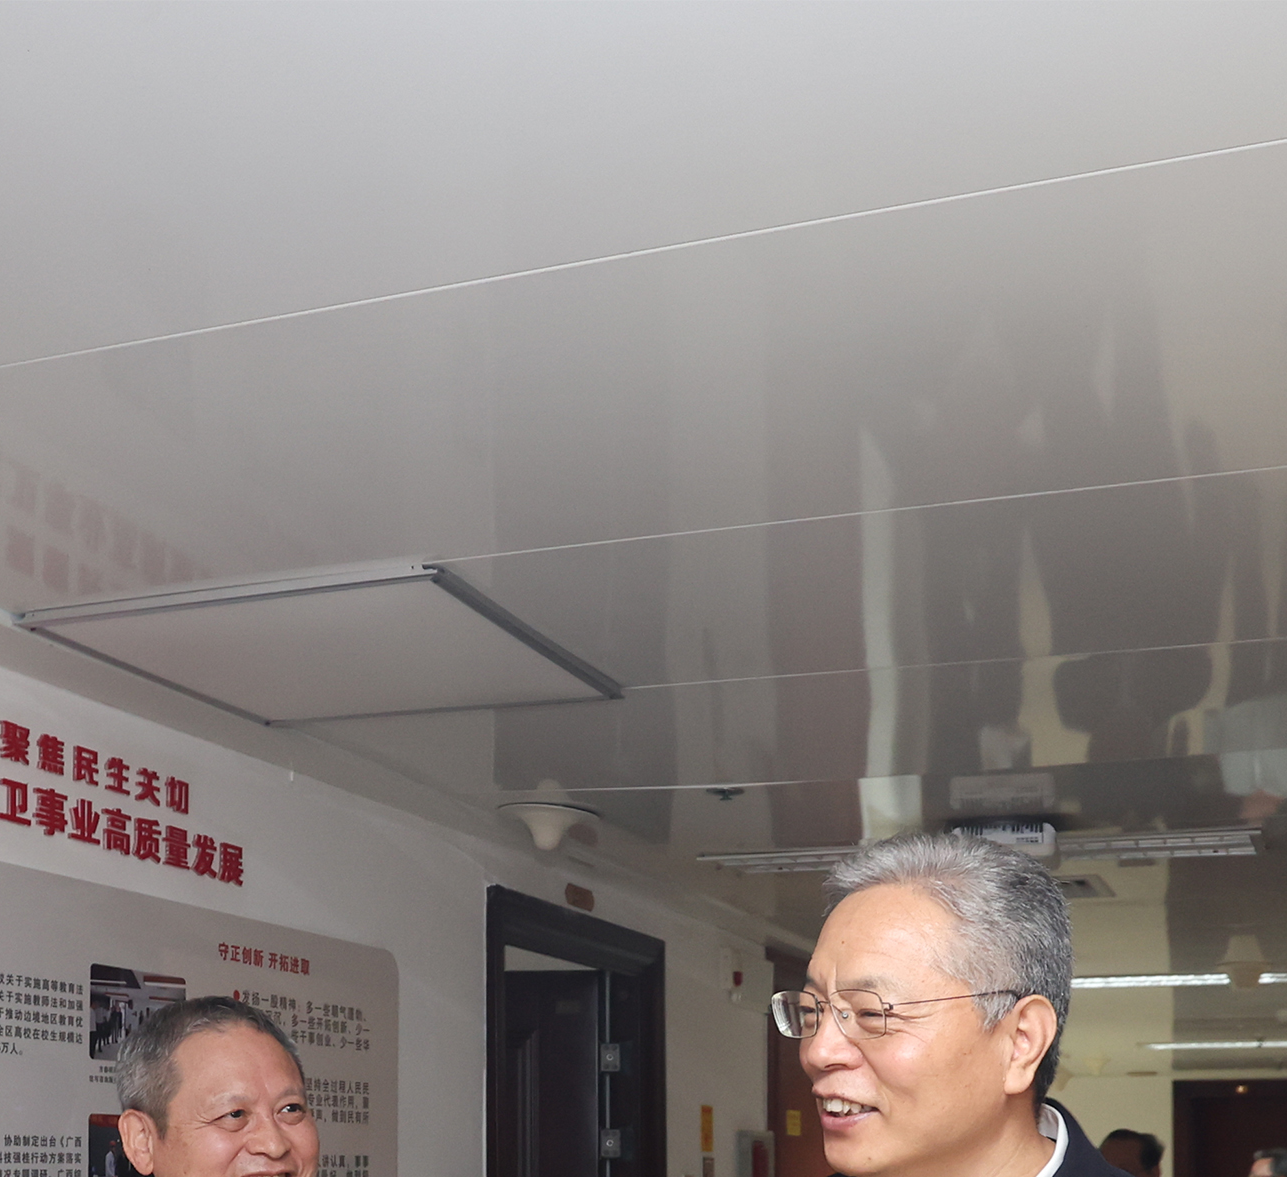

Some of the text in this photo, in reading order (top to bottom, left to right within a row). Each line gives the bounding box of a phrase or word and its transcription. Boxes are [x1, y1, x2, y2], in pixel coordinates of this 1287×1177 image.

[0, 720, 189, 814] 聚焦民生关切
[218, 942, 310, 976] 守正创新 开拓进取
